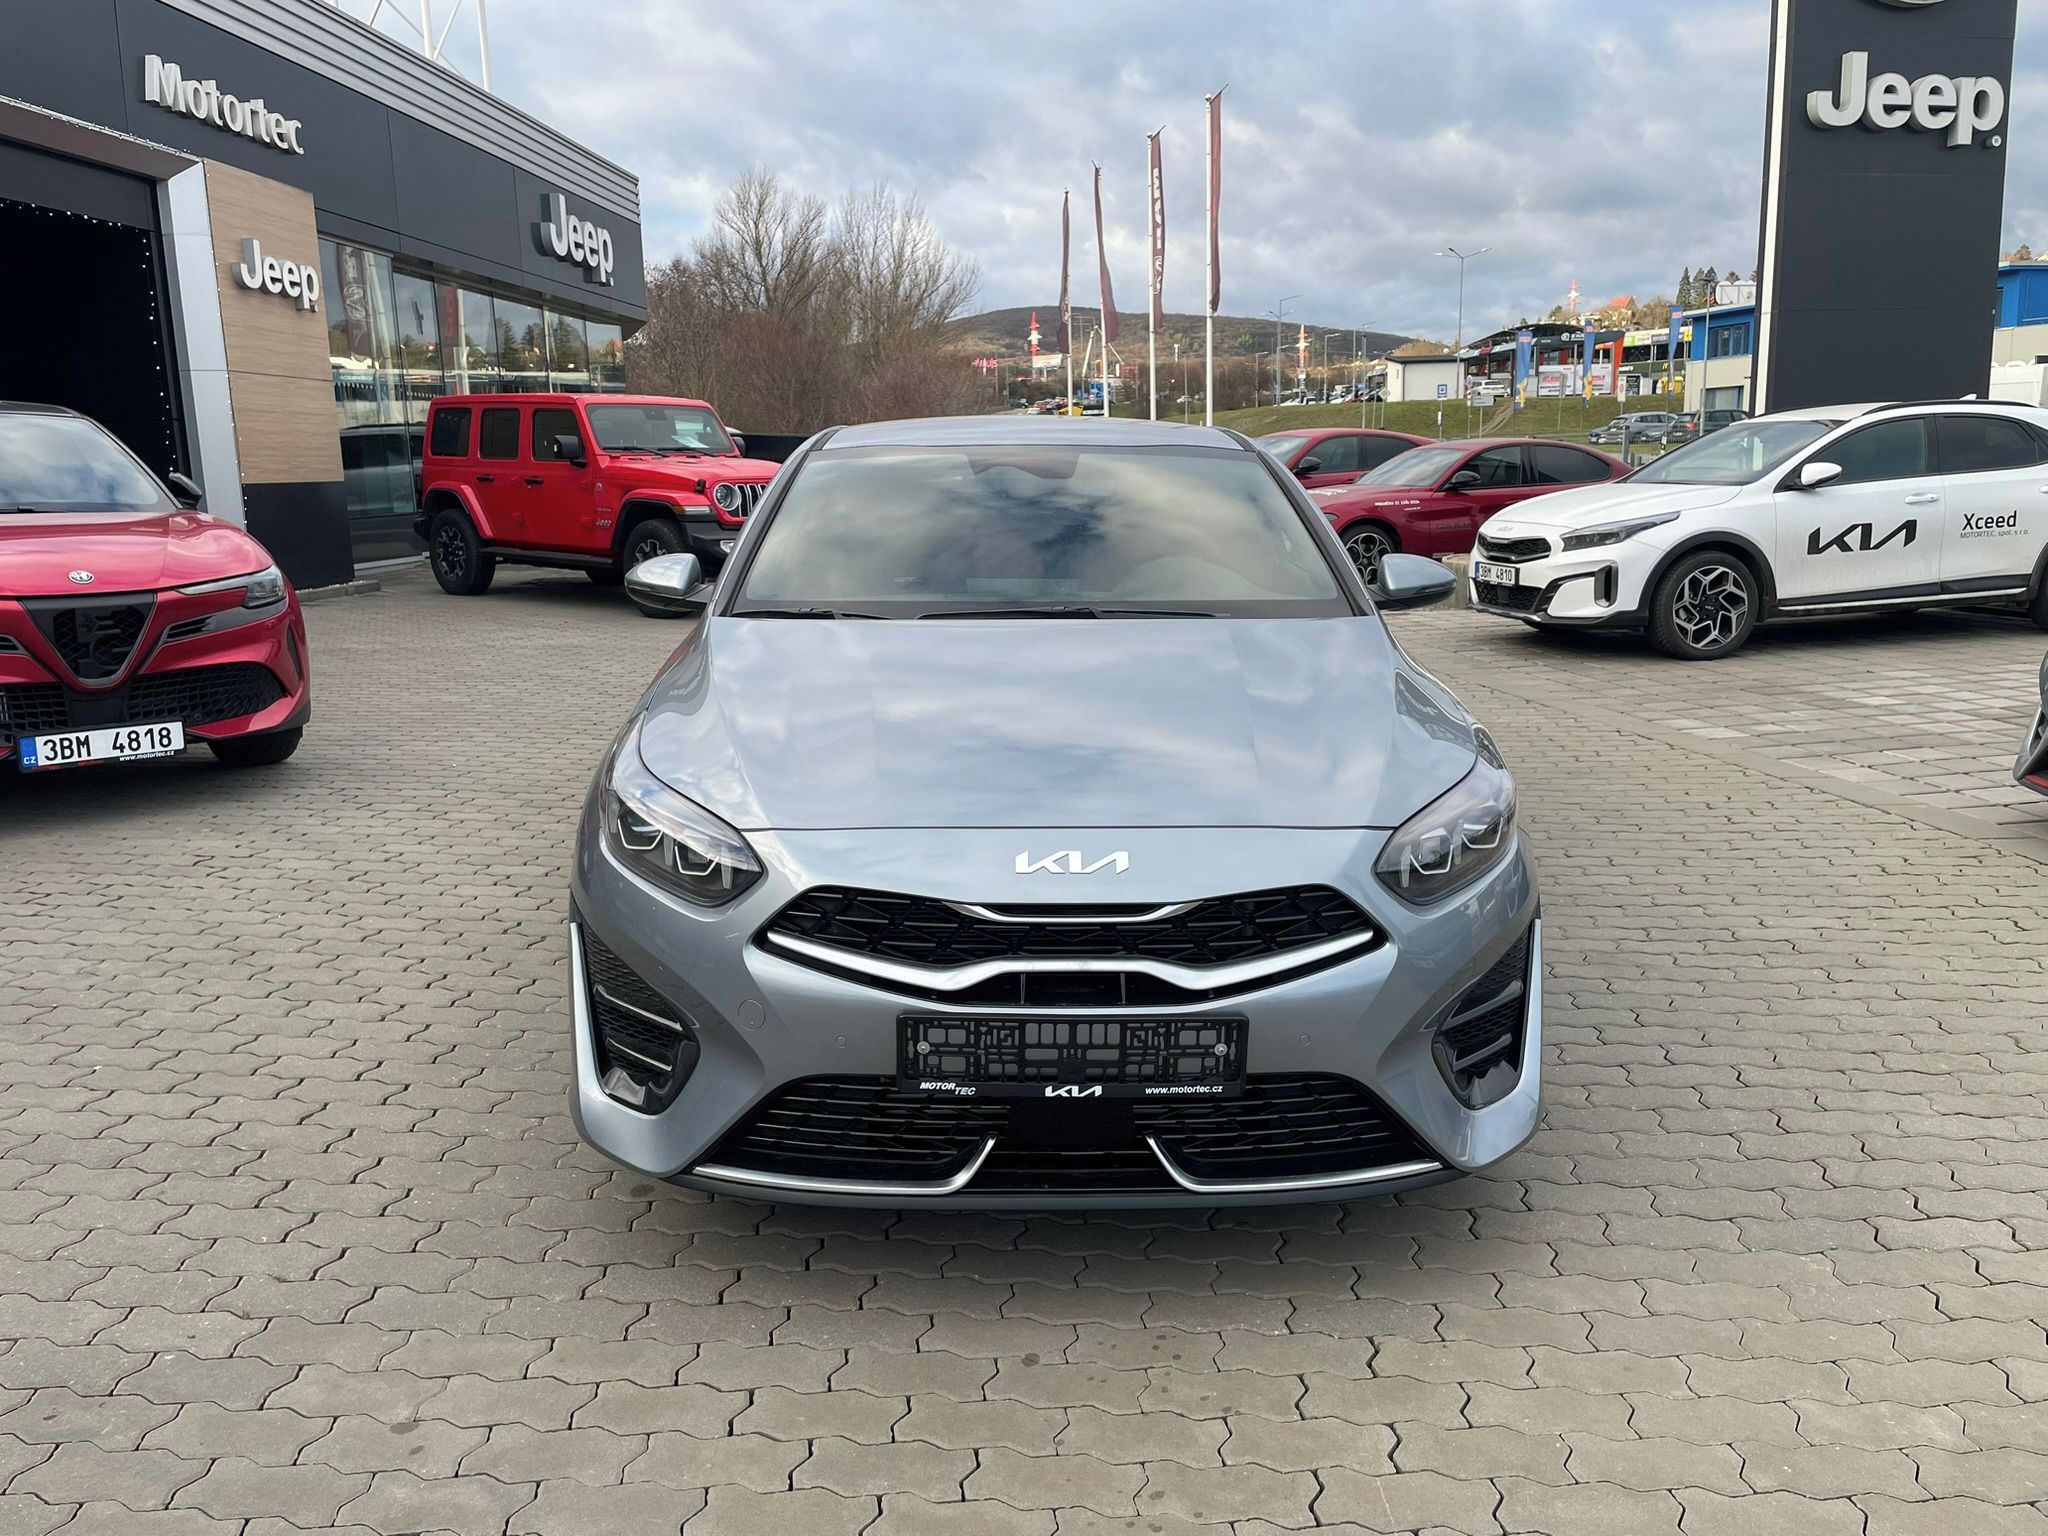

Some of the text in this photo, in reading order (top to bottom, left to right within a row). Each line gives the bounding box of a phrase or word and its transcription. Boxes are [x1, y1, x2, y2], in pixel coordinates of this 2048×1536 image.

[144, 54, 305, 155] Motortec
[1806, 50, 2005, 147] Jeep
[536, 192, 614, 284] Jeep
[232, 237, 320, 311] Jeep
[1806, 519, 1918, 555] KIA
[1962, 510, 2017, 531] Xceed
[1480, 565, 1513, 582] 3BM 4810
[23, 726, 172, 765] CZ 3BM 4818
[119, 750, 175, 763] www.motortec.cz
[1015, 850, 1129, 875] KIA
[1145, 1084, 1223, 1095] www.motortec.cz
